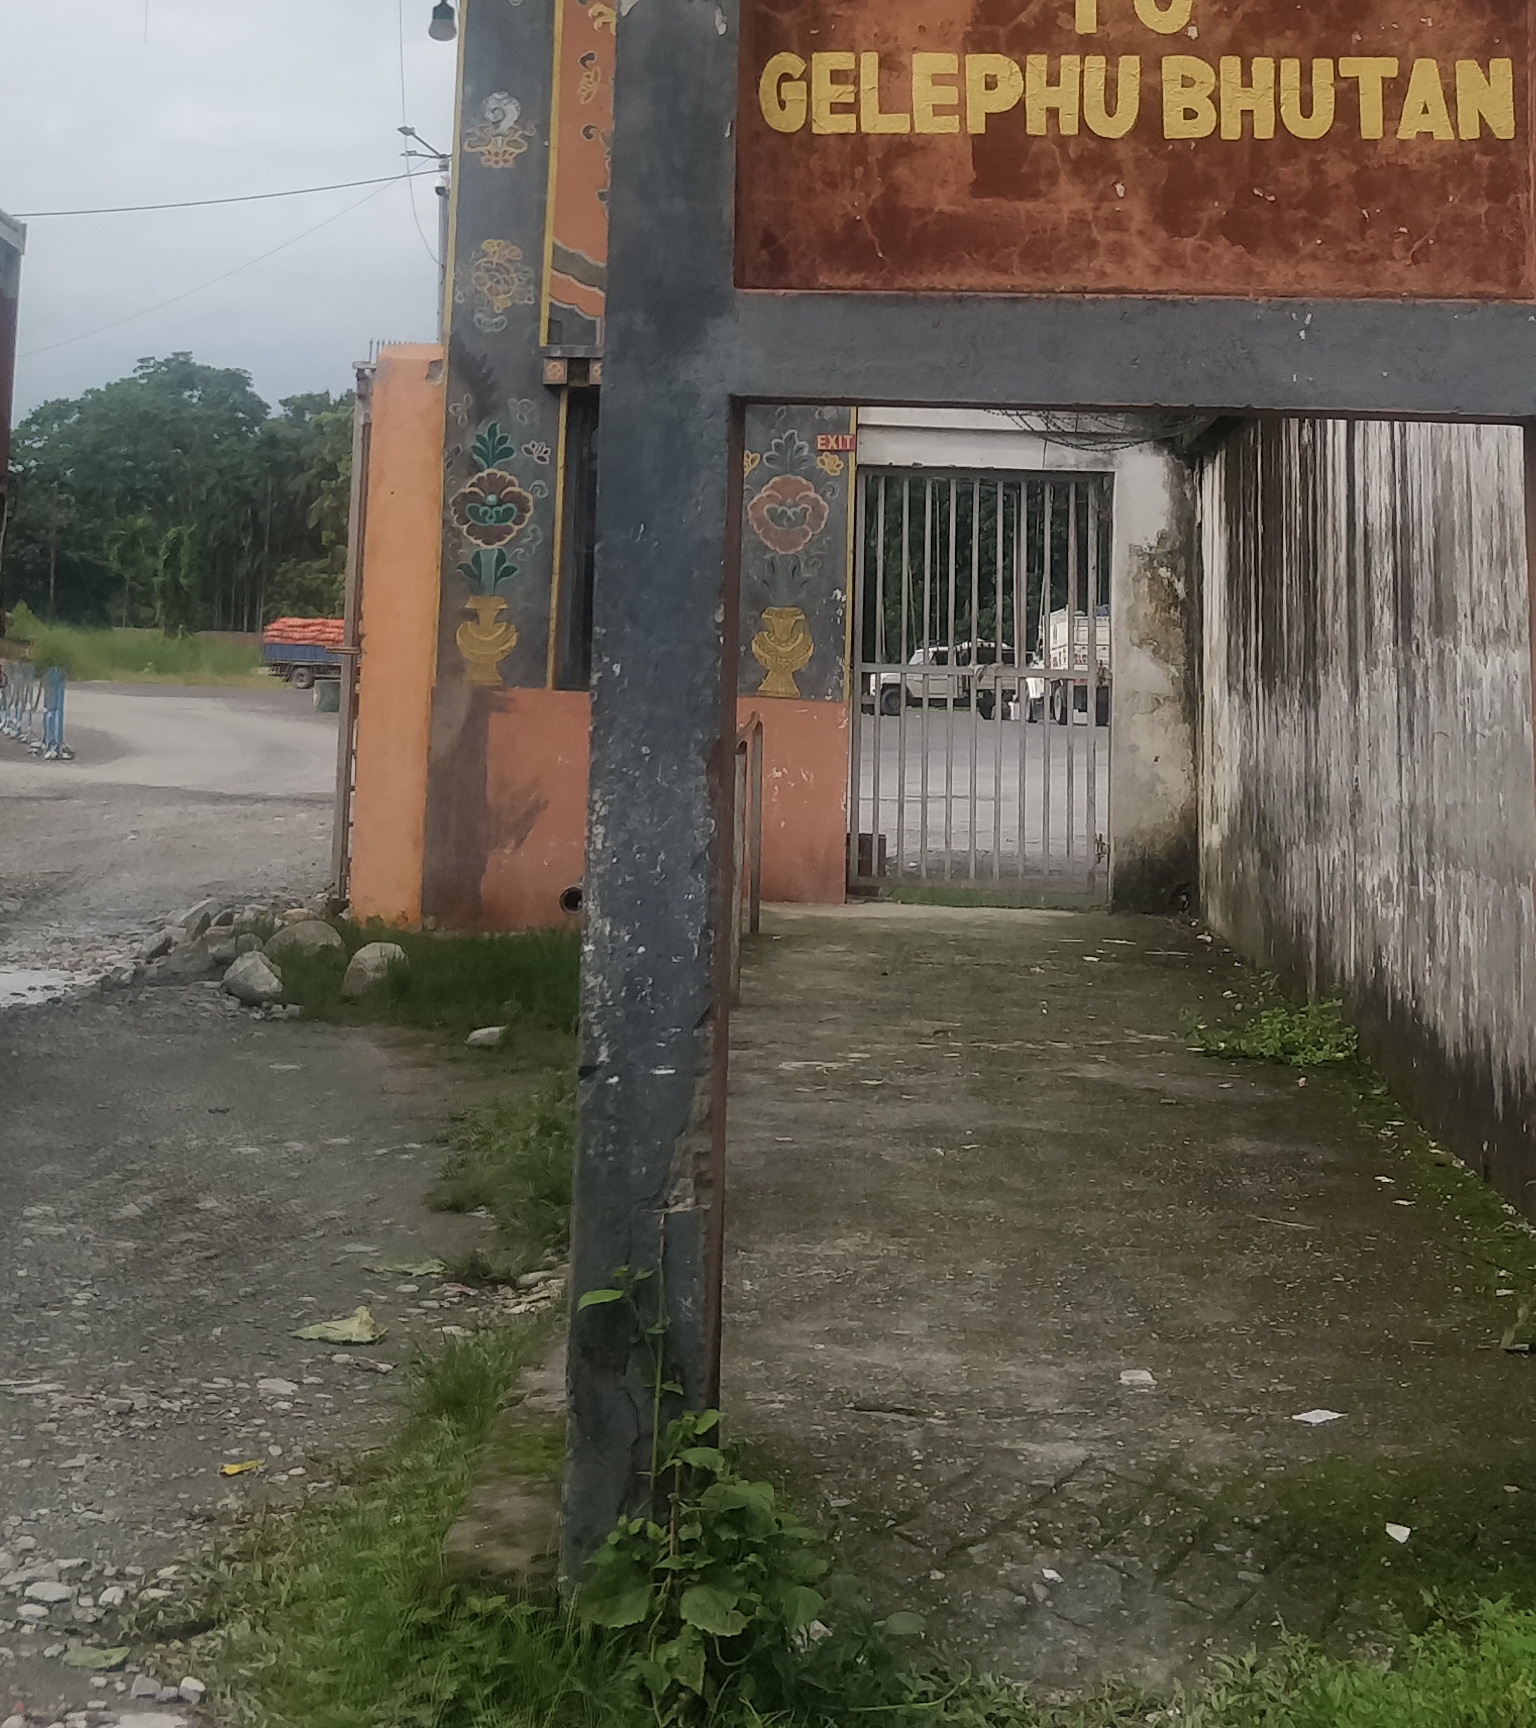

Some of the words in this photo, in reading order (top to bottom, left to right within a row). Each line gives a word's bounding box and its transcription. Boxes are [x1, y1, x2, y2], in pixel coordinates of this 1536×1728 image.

[758, 50, 1141, 136] GELEPHU
[1162, 56, 1516, 142] BHUTAN
[817, 434, 853, 450] EXIT
